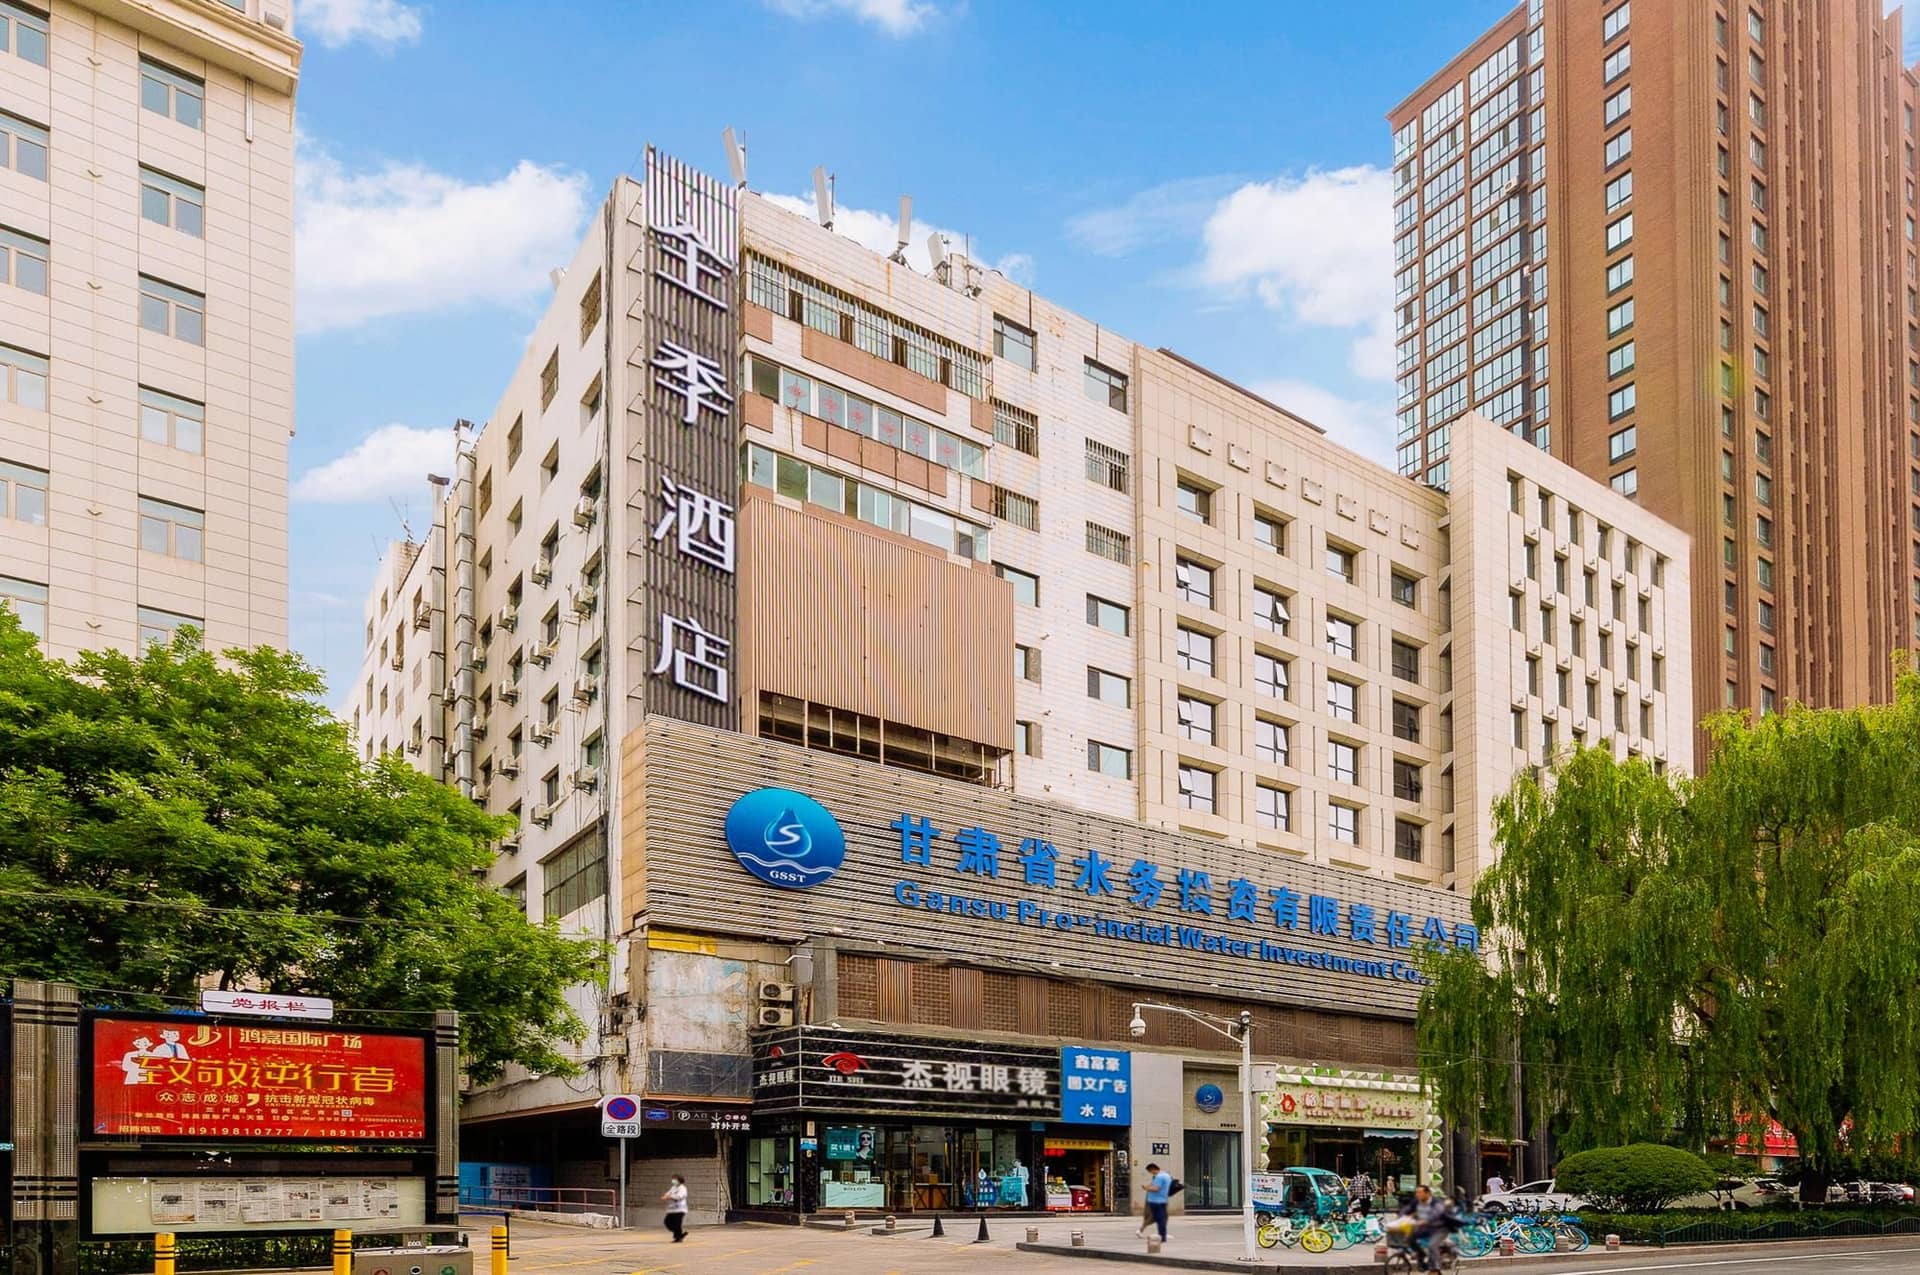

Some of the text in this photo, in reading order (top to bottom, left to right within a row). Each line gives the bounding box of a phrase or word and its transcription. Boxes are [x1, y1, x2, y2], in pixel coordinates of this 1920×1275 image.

[769, 868, 807, 884] GSST
[890, 812, 1479, 954] 甘肃省水务投资有限责任公司
[894, 879, 1008, 921] Gansu
[1178, 925, 1253, 958] Water
[1260, 939, 1387, 978] Investment
[239, 1027, 362, 1049] 鸿嘉国际广场
[131, 1055, 396, 1093] 致敬逆行者
[901, 1059, 1047, 1096] 杰视眼镜
[1067, 1075, 1128, 1094] 图文广告
[265, 1094, 375, 1106] 抗击新型冠状病毒
[178, 1126, 293, 1137] 18919810777
[606, 1124, 637, 1135] 全路段
